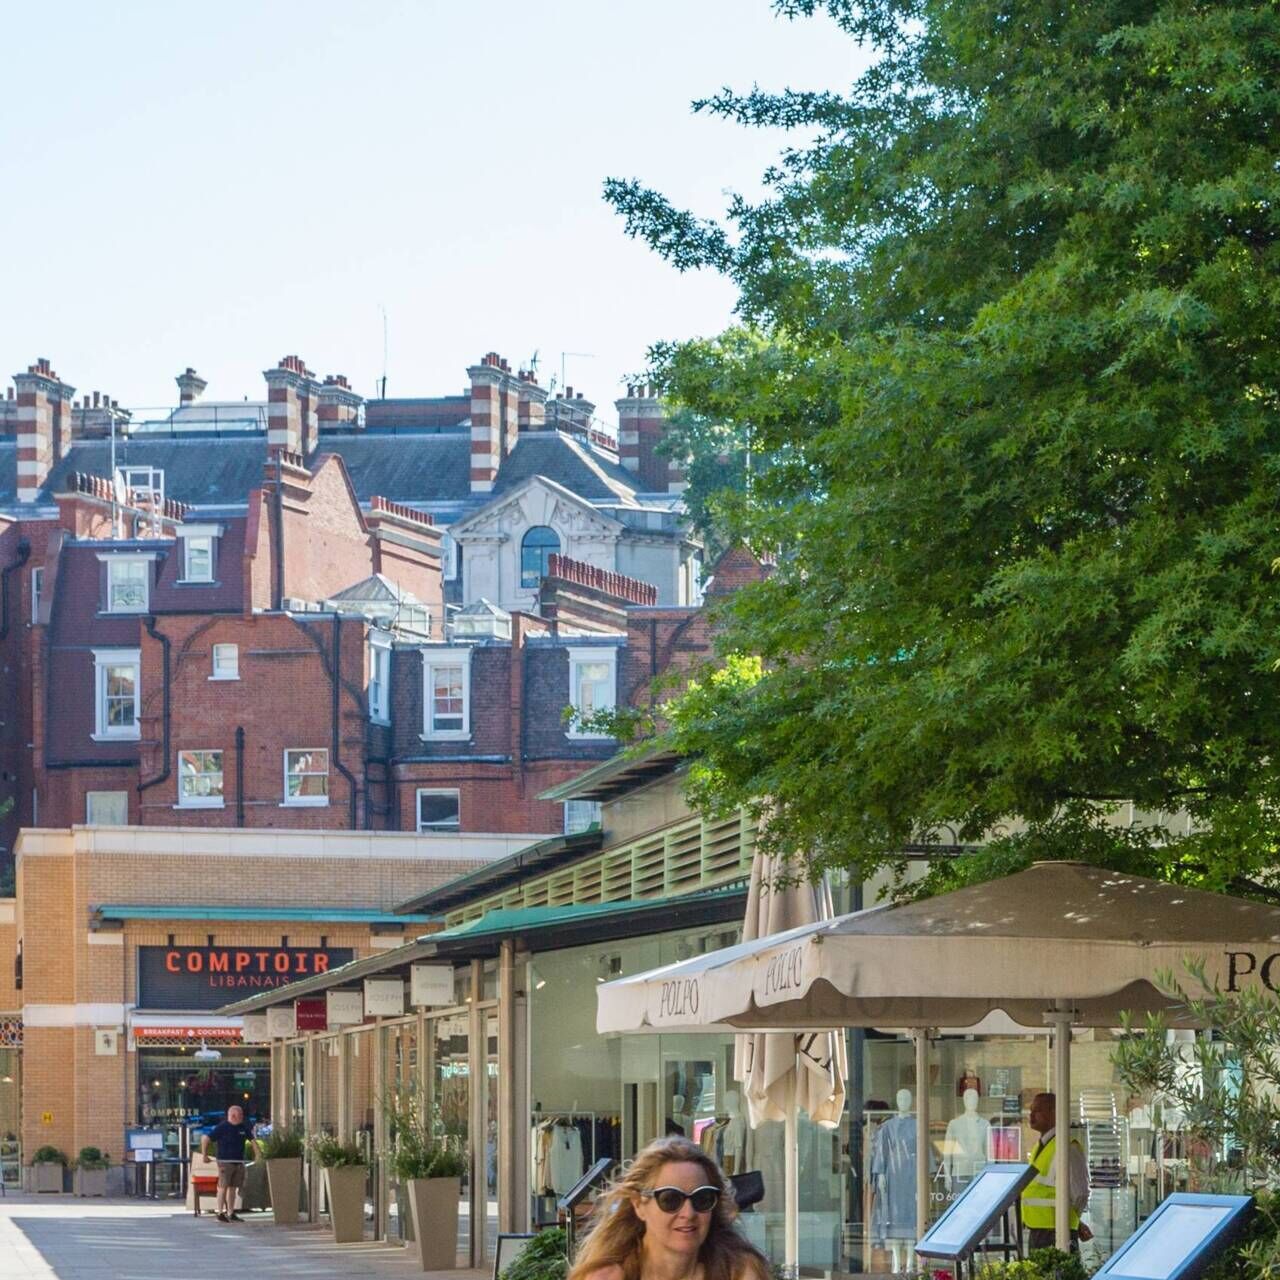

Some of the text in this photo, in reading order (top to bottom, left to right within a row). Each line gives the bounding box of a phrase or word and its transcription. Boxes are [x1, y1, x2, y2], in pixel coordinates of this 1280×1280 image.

[166, 951, 330, 973] COMPTOIR
[765, 946, 803, 996] POLPO
[209, 976, 290, 987] LIBANAIS
[658, 977, 699, 1018] POLPO
